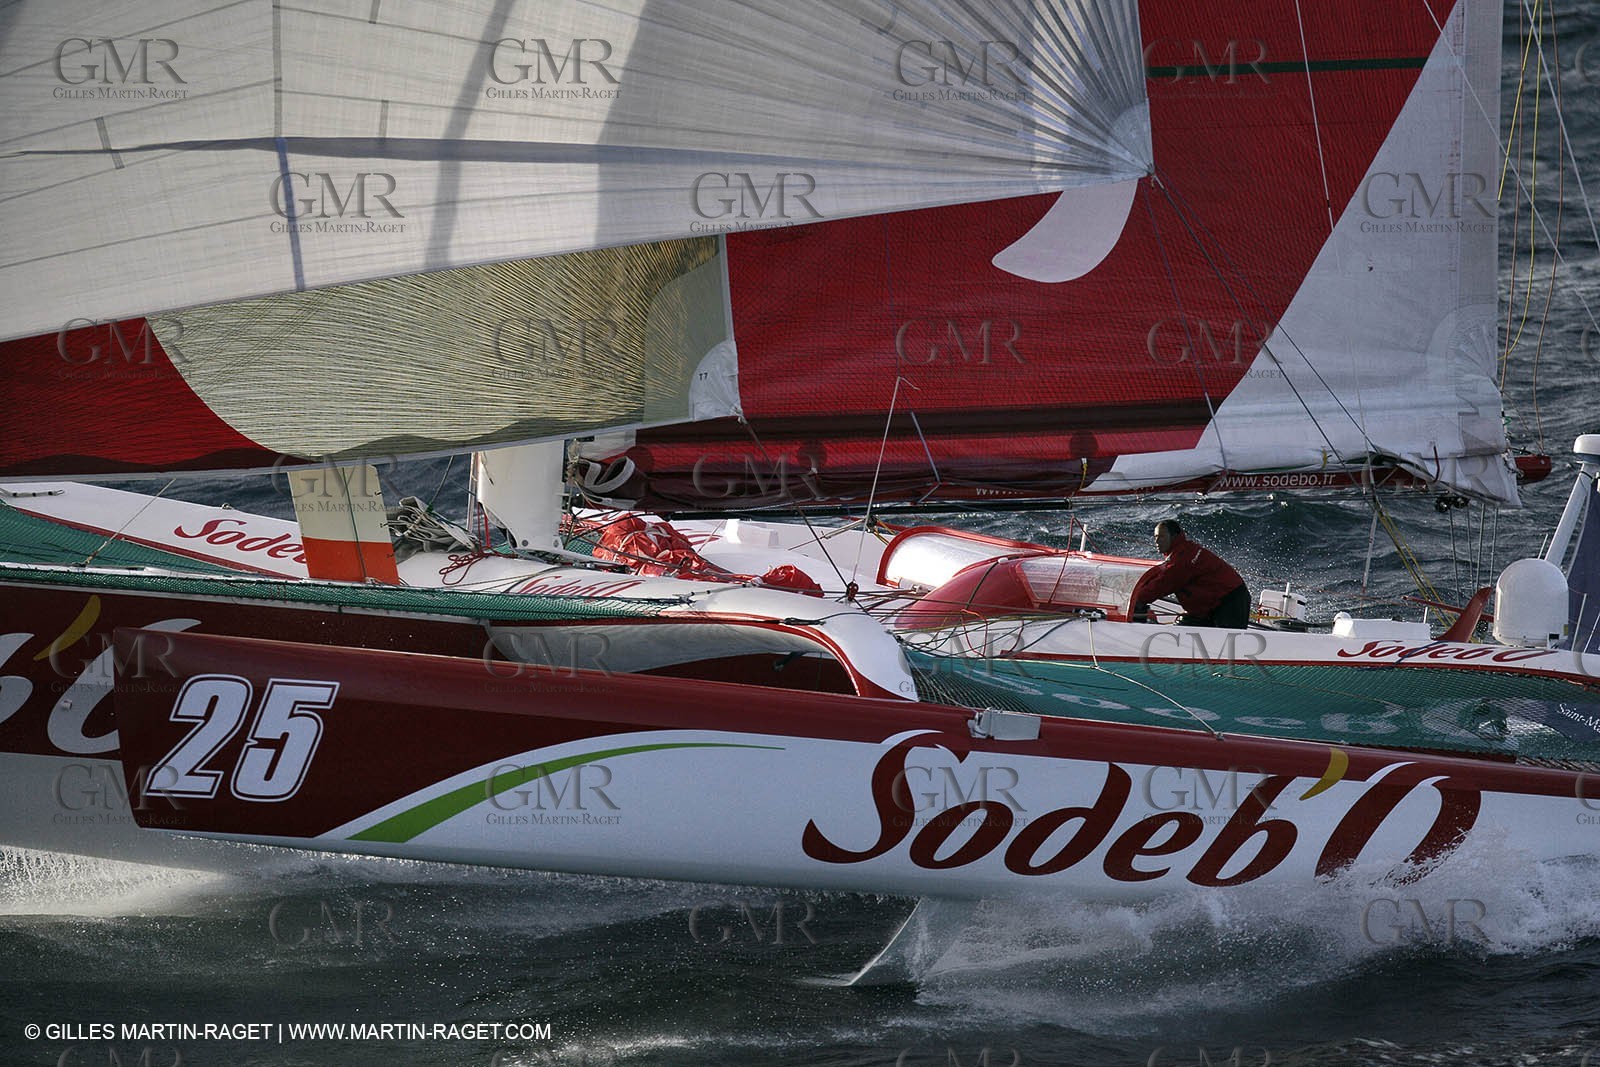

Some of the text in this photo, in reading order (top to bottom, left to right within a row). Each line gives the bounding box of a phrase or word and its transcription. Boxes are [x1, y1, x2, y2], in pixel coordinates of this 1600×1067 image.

[1220, 472, 1336, 488] www.sodebo.fr
[144, 673, 340, 803] 25
[802, 729, 1482, 888] Sodeb'O
